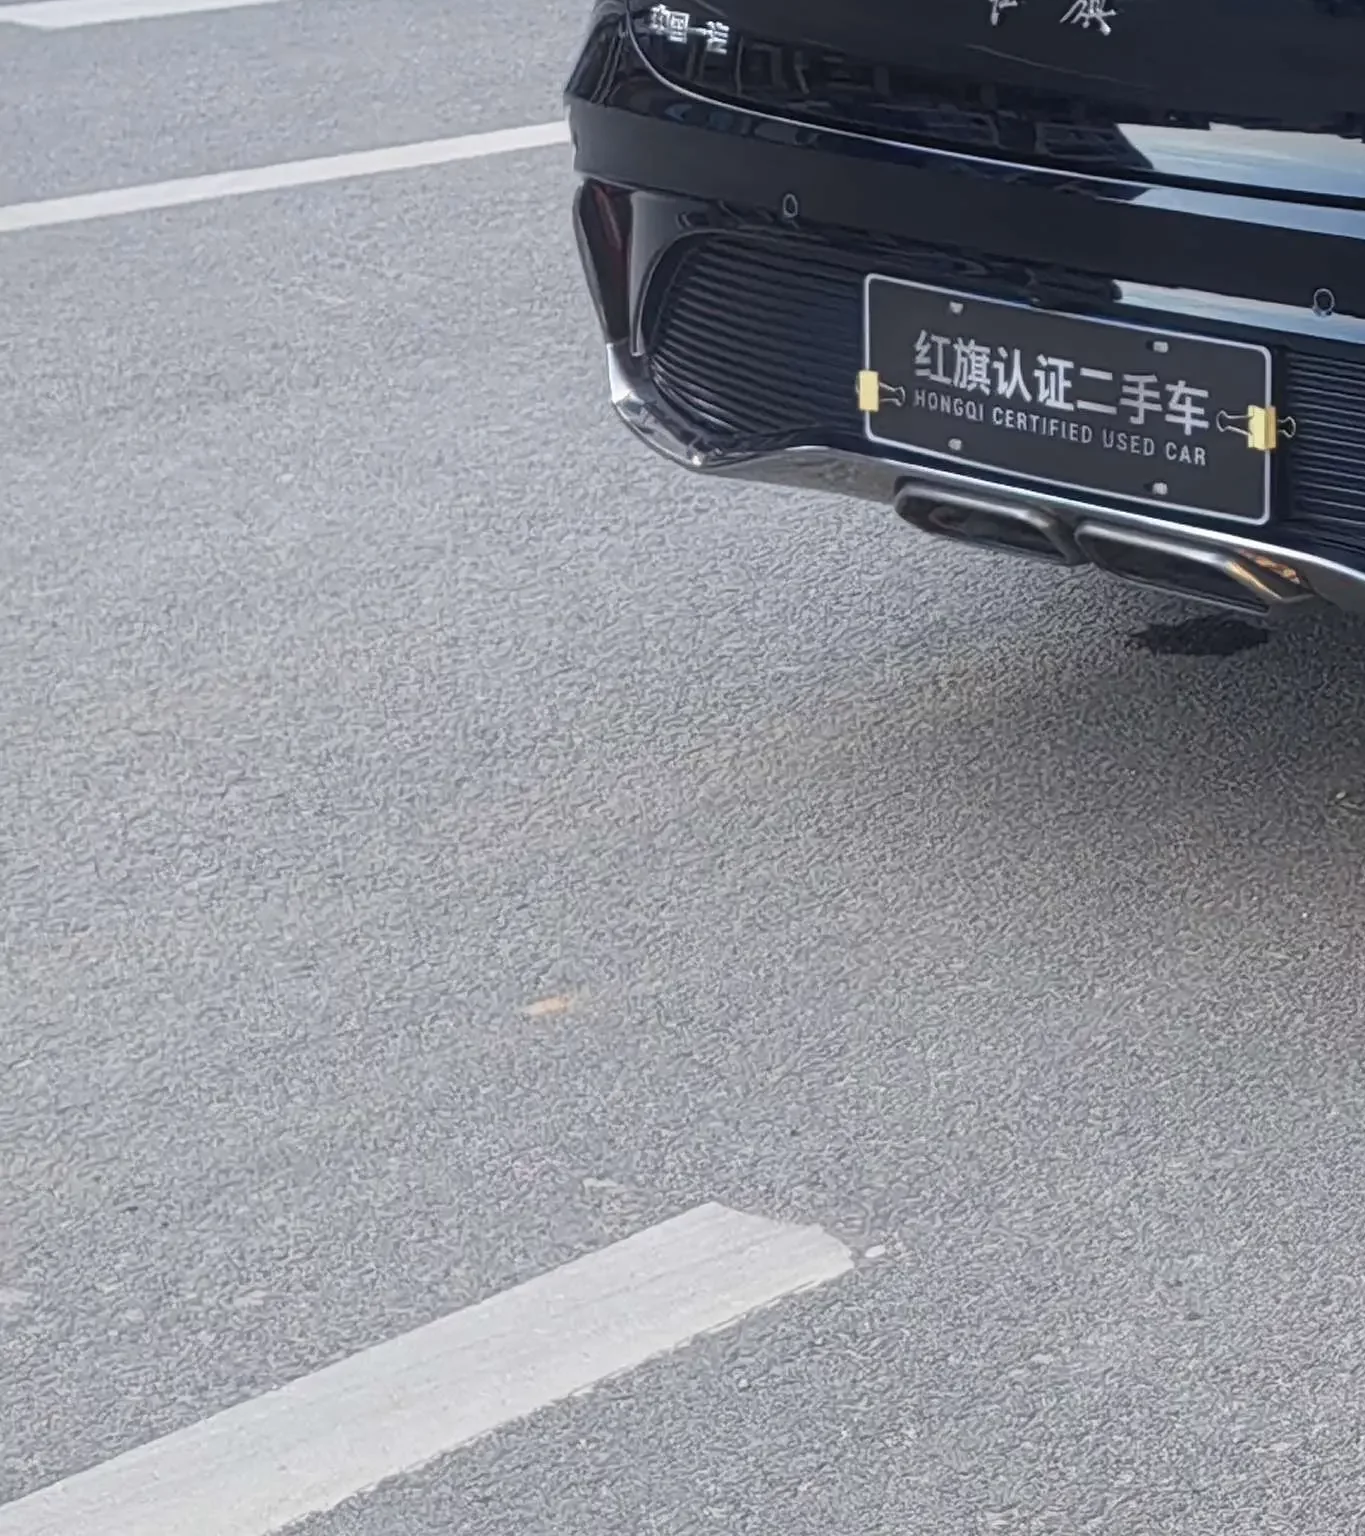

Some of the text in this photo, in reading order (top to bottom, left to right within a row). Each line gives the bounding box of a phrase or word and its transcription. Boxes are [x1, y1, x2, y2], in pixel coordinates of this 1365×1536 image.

[913, 329, 1210, 437] 红旗认证二手车
[913, 388, 1207, 467] HONGQI CERTIFIED USED CAR
